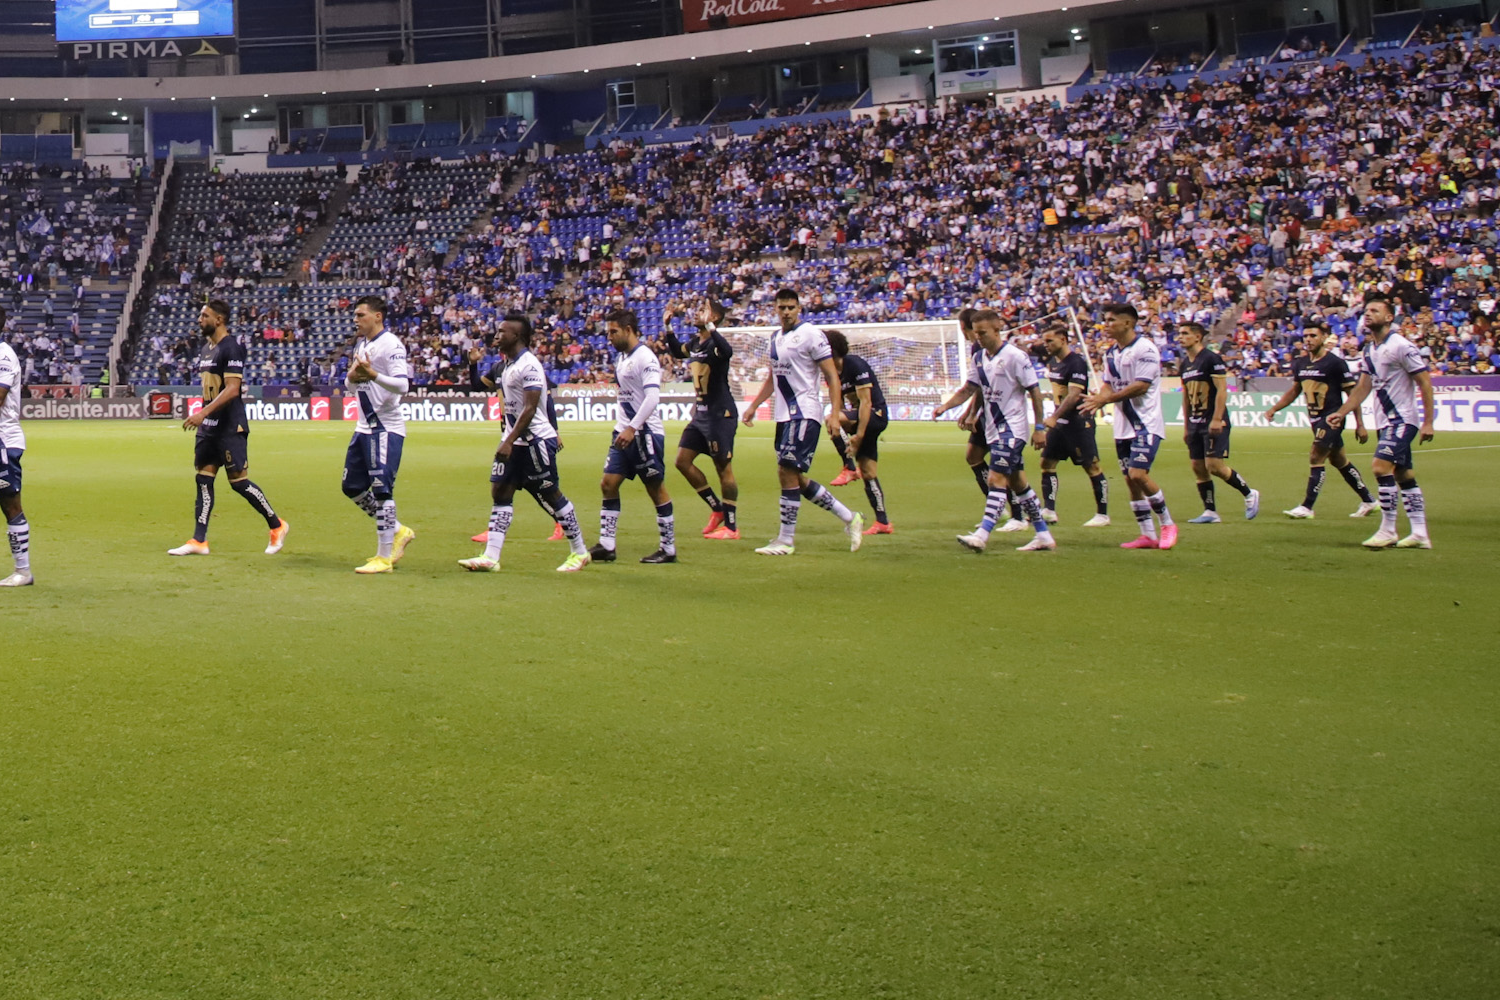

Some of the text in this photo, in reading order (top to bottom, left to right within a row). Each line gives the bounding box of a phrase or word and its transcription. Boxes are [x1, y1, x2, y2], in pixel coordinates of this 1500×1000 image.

[74, 40, 182, 60] PIRMA
[22, 400, 141, 418] caliente.mx
[1316, 428, 1326, 439] 10
[491, 462, 505, 476] 20
